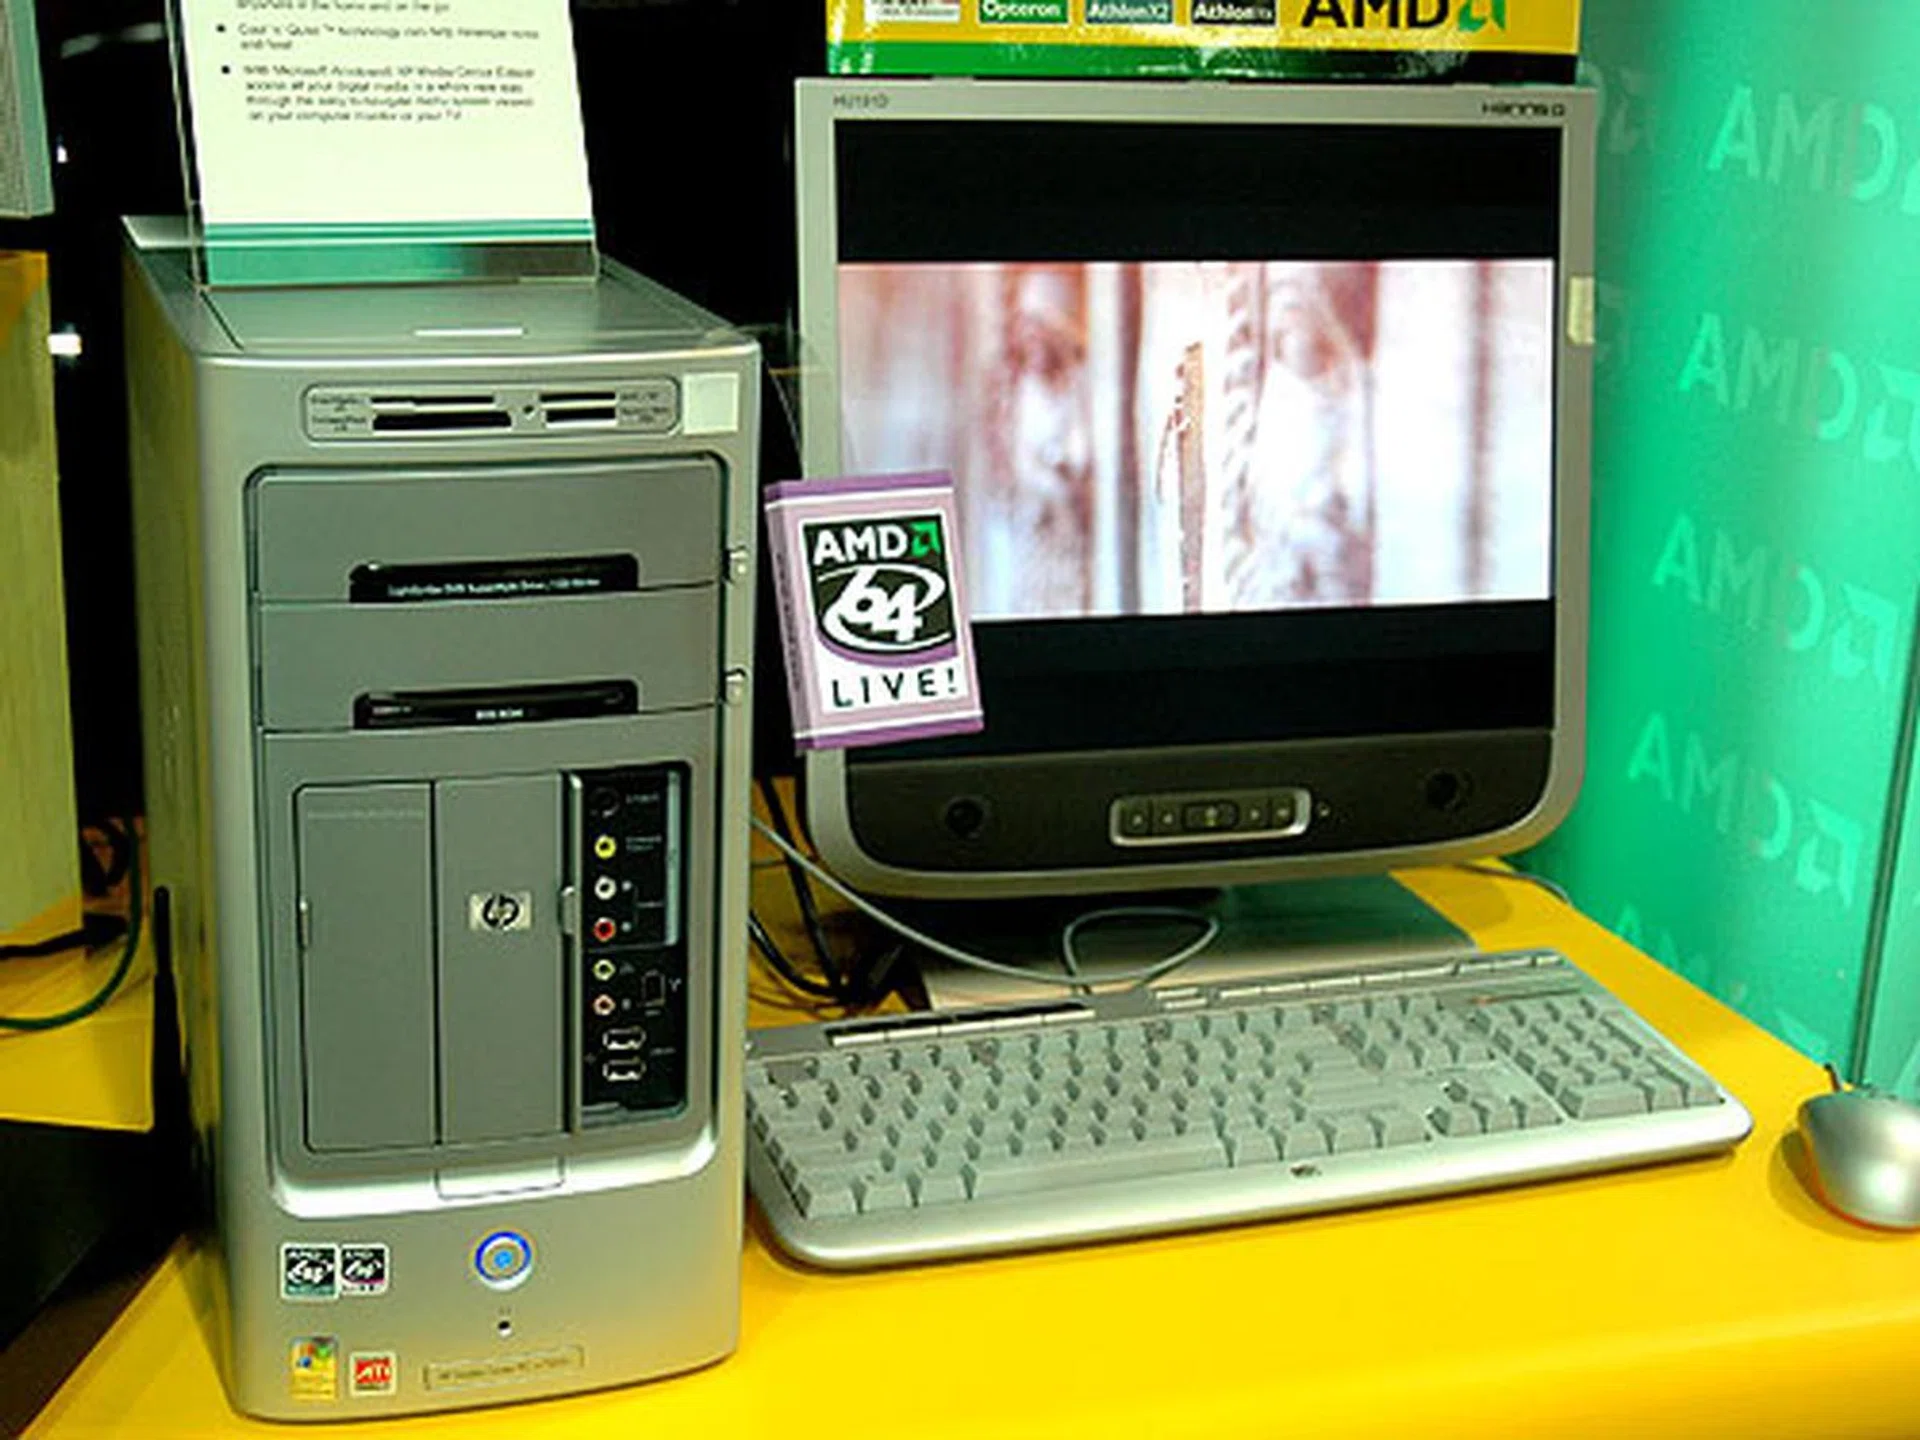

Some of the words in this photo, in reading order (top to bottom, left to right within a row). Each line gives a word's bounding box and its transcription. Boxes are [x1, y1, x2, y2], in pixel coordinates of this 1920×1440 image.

[1301, 0, 1450, 28] AMD
[1705, 83, 1898, 202] AMD
[1677, 312, 1860, 441] AMD
[813, 523, 908, 566] AMD
[1651, 513, 1827, 653] AMD
[832, 564, 928, 643] 64
[831, 668, 957, 709] LIVE!
[1628, 712, 1793, 862] AMD
